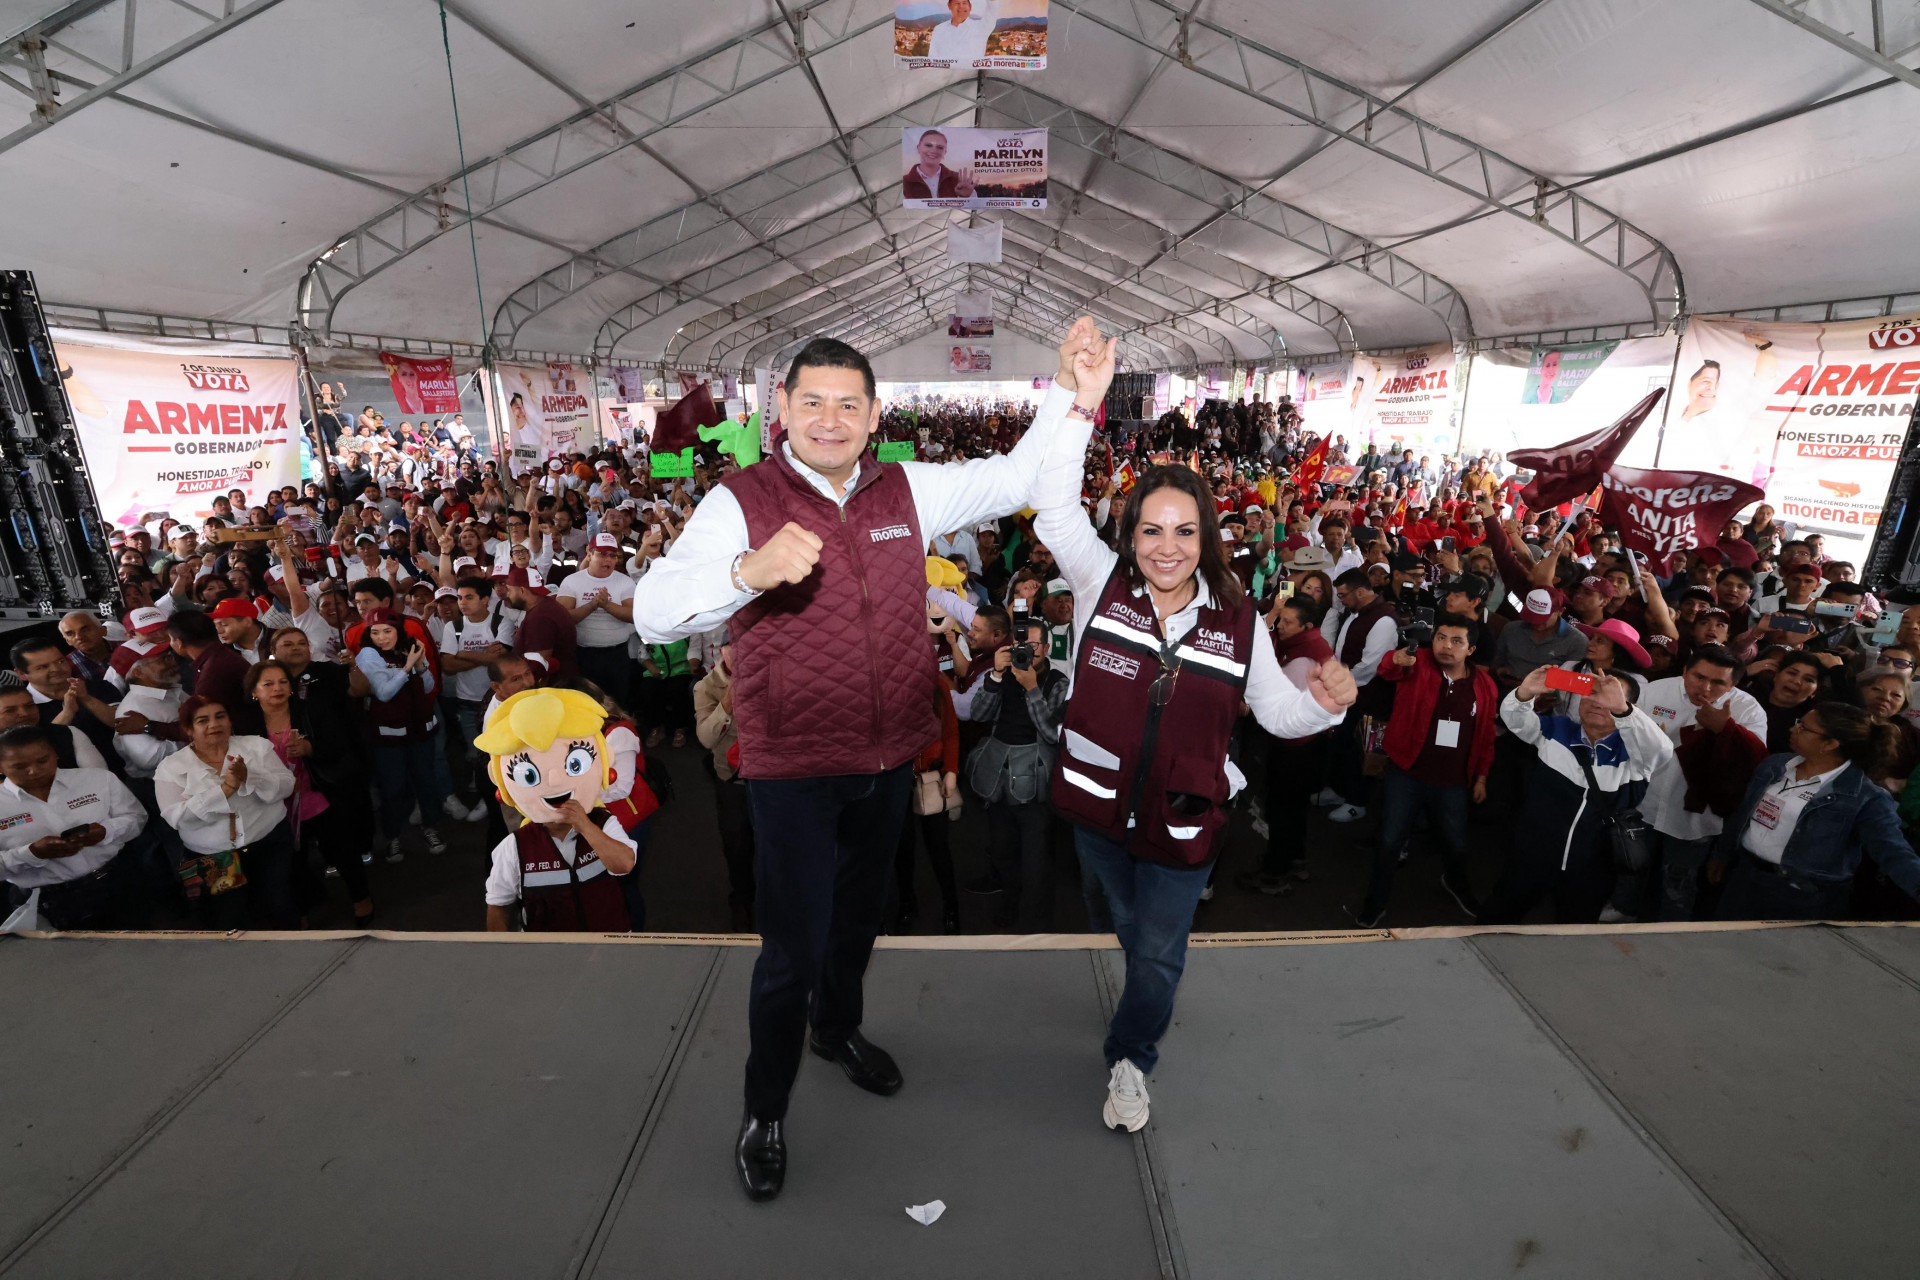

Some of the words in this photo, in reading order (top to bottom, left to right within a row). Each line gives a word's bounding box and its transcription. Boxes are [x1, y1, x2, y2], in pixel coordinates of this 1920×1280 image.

[974, 149, 1043, 159] MARILYN
[1872, 327, 1920, 347] VO
[180, 364, 188, 372] 2
[189, 364, 205, 372] DE
[1408, 358, 1428, 369] VOTA
[185, 372, 248, 390] VOTA
[420, 380, 454, 390] MARILYN
[1380, 370, 1448, 394] ARMENTA
[1774, 361, 1920, 396] ARME
[123, 400, 288, 434] ARMENTA
[763, 374, 775, 448] HUEYTAMALCO
[1777, 431, 1875, 446] HONESTIDAD,
[1882, 434, 1905, 444] TR
[174, 440, 262, 454] GOBERNADOR
[1800, 445, 1849, 457] AMOR
[1849, 445, 1861, 456] A
[157, 469, 228, 481] HONESTIDAD,
[266, 461, 270, 469] Y
[178, 478, 213, 492] AMOR
[215, 478, 222, 489] A
[1603, 472, 1738, 508] morena
[1814, 500, 1849, 508] HACIENDO
[1628, 503, 1696, 535] ANITA
[1783, 502, 1860, 524] morena
[870, 527, 912, 542] morena
[1109, 602, 1152, 625] morena
[1111, 611, 1130, 623] esperanza
[67, 793, 97, 805] MAESTRA
[526, 863, 536, 871] DIP.
